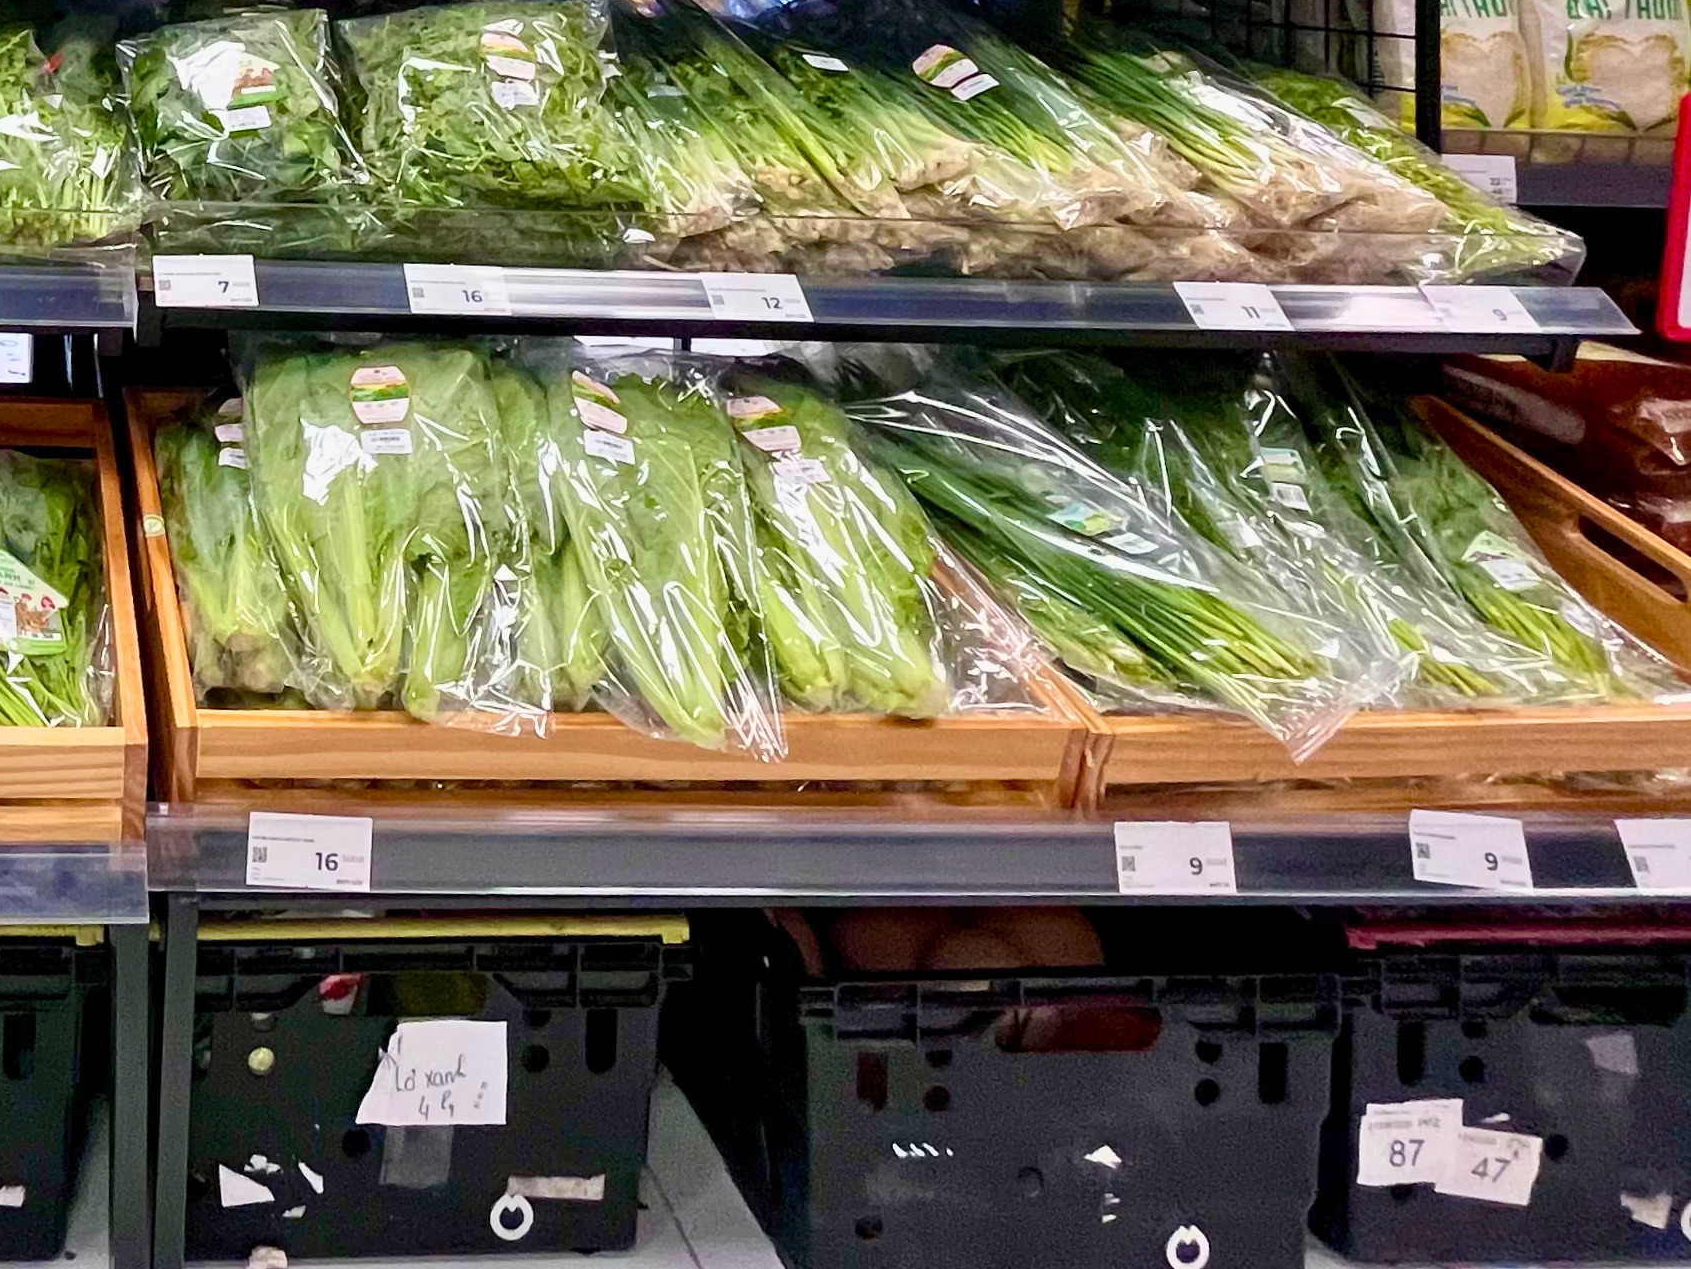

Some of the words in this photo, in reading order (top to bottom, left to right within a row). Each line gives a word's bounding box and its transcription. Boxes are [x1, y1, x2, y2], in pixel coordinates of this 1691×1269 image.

[218, 281, 230, 294] 7
[461, 290, 483, 303] 16
[762, 296, 783, 309] 12
[1241, 306, 1260, 318] 11
[314, 851, 339, 872] 16
[1188, 857, 1203, 876] 9
[1483, 852, 1499, 871] 9
[1388, 1138, 1425, 1168] 87
[1470, 1156, 1512, 1184] 47
